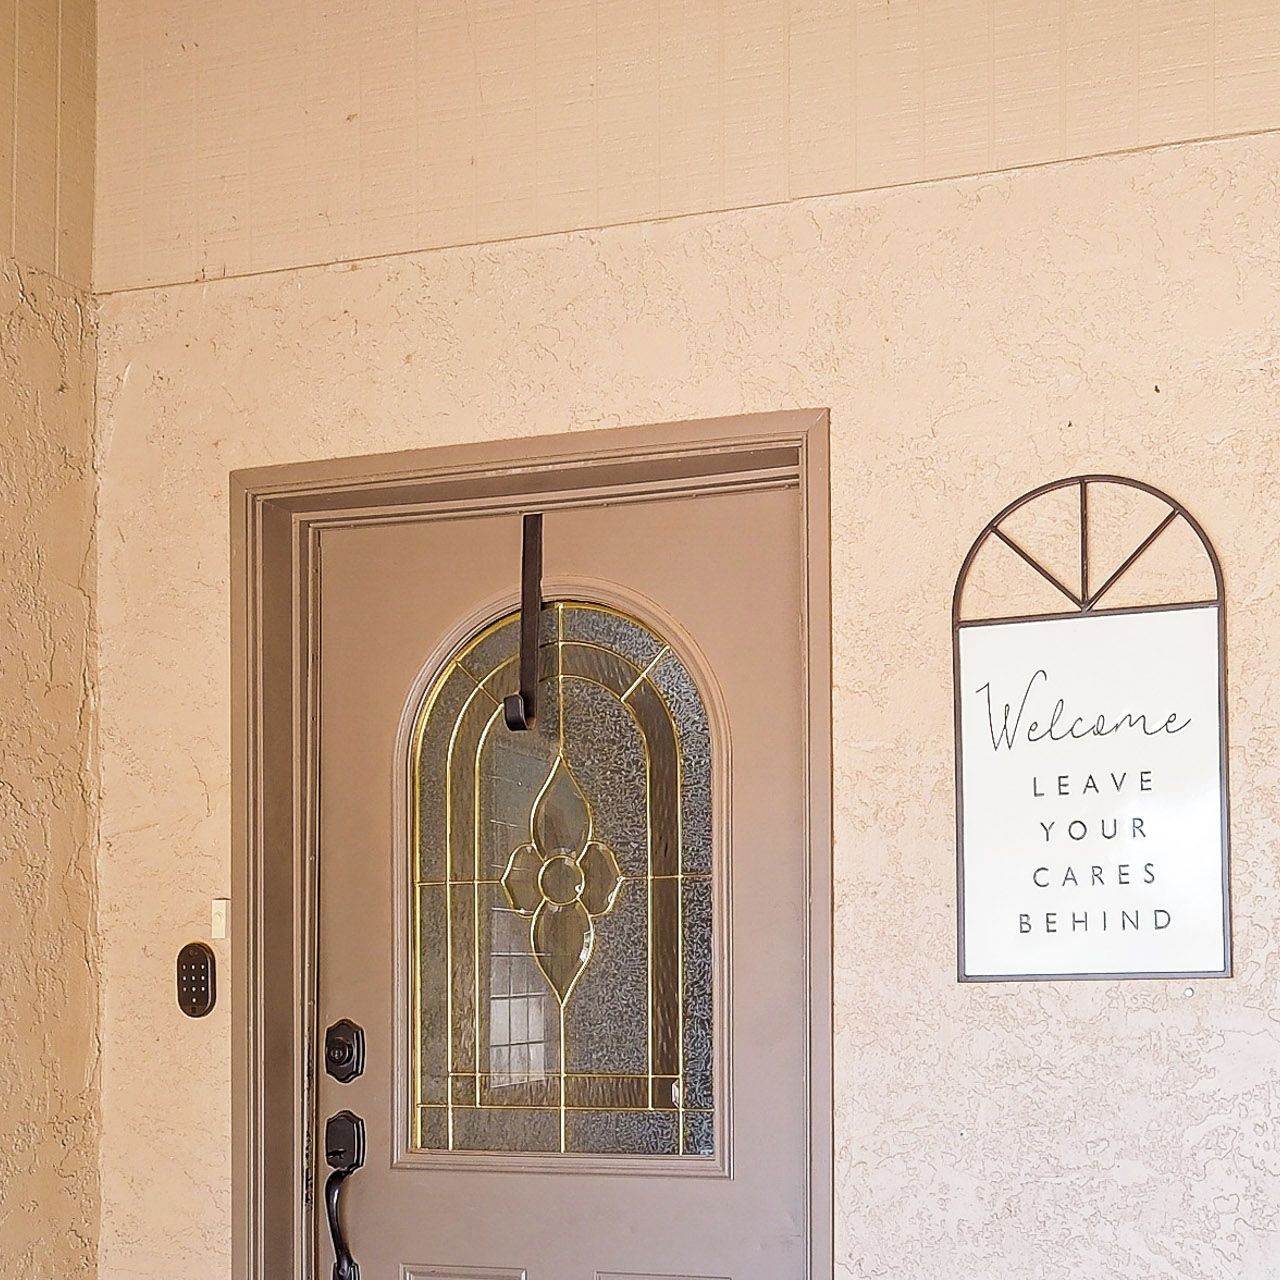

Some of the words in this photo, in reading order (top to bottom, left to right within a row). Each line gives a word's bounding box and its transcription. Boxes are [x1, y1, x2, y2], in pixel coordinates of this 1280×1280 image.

[975, 669, 1192, 752] Welcome
[1033, 770, 1153, 798] LEAVE
[1039, 817, 1148, 842] YOUR
[1032, 862, 1157, 888] CARES
[1019, 909, 1172, 934] BEHIND
